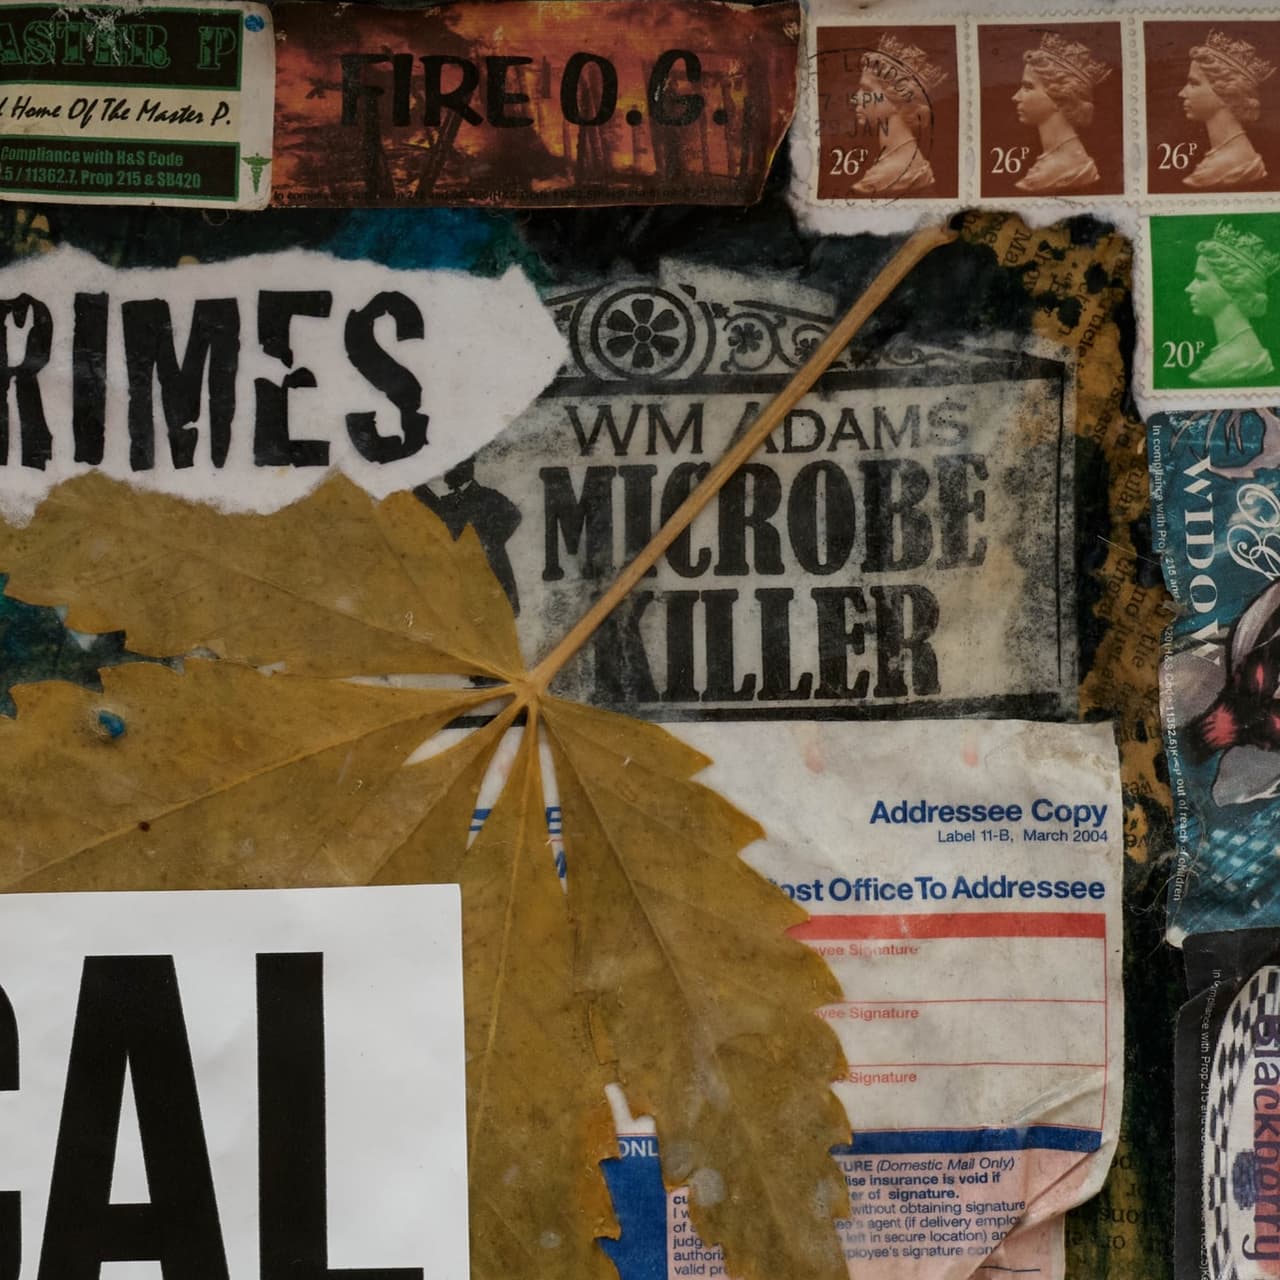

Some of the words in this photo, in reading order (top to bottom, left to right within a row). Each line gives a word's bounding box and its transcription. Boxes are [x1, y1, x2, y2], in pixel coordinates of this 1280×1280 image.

[195, 25, 238, 70] P
[342, 51, 535, 128] FIRE
[558, 47, 730, 129] O.G.
[12, 95, 63, 120] Home
[67, 97, 97, 128] Of
[102, 97, 130, 121] The
[136, 98, 204, 124] Master
[209, 101, 232, 127] P.
[0, 146, 81, 167] Compliance
[83, 149, 114, 166] with
[116, 150, 146, 167] H&S
[147, 151, 185, 168] Code
[80, 168, 113, 188] Prop
[116, 170, 142, 186] 215
[155, 171, 202, 189] SB420
[563, 401, 704, 458] WM
[539, 451, 990, 583] MICROBE
[1182, 455, 1222, 667] WIDOW
[868, 799, 1024, 826] Addressee
[1030, 798, 1109, 828] Copy
[936, 830, 975, 845] Label
[977, 830, 1015, 845] 11-B,
[1022, 829, 1066, 844] March
[1070, 828, 1109, 843] 2004
[826, 874, 914, 902] Office
[914, 875, 949, 902] To
[951, 873, 1107, 901] Addressee
[849, 942, 921, 959] Signature
[876, 1157, 944, 1173] (Domestic
[947, 1157, 976, 1171] Mail
[978, 1156, 1015, 1172] Only)
[869, 1173, 940, 1187] insurance
[887, 1188, 960, 1203] signature.
[899, 1200, 963, 1216] obtaining
